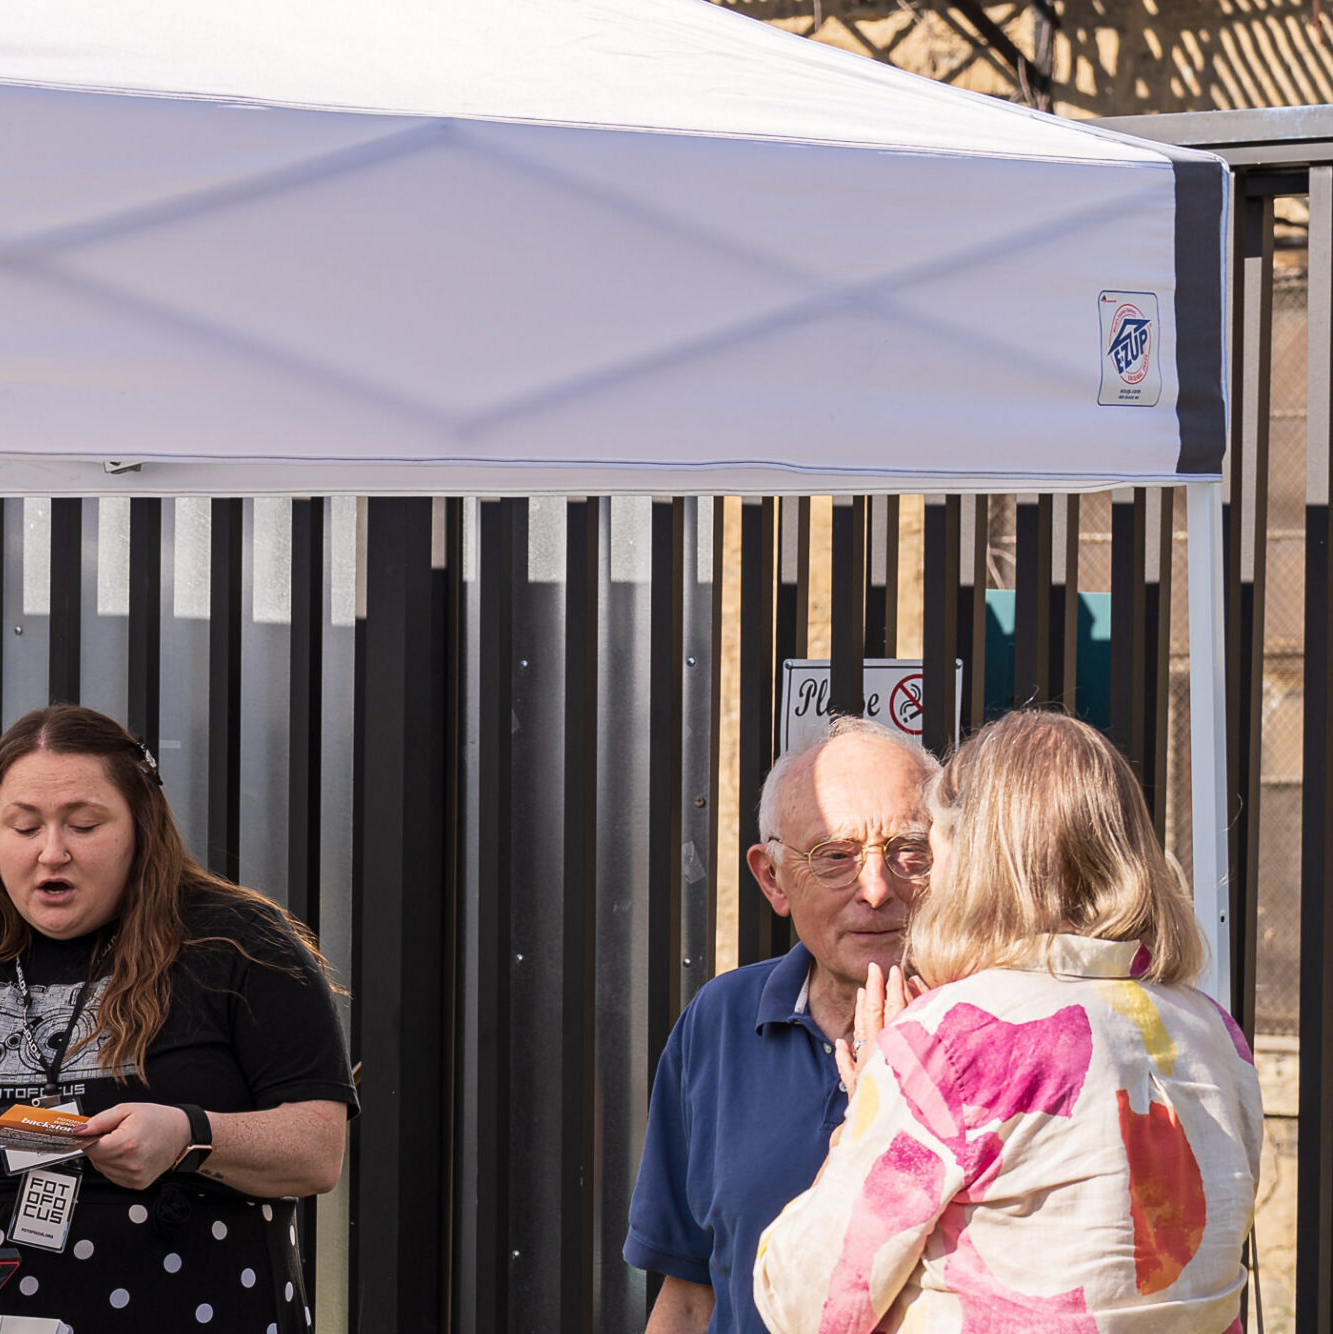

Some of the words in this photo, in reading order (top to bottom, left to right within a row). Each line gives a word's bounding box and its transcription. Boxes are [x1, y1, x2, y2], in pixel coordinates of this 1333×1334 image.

[794, 677, 881, 717] Ple
[21, 1117, 74, 1133] backstor
[30, 1177, 70, 1196] FOT
[27, 1191, 67, 1210] OFO
[23, 1204, 64, 1224] CUS
